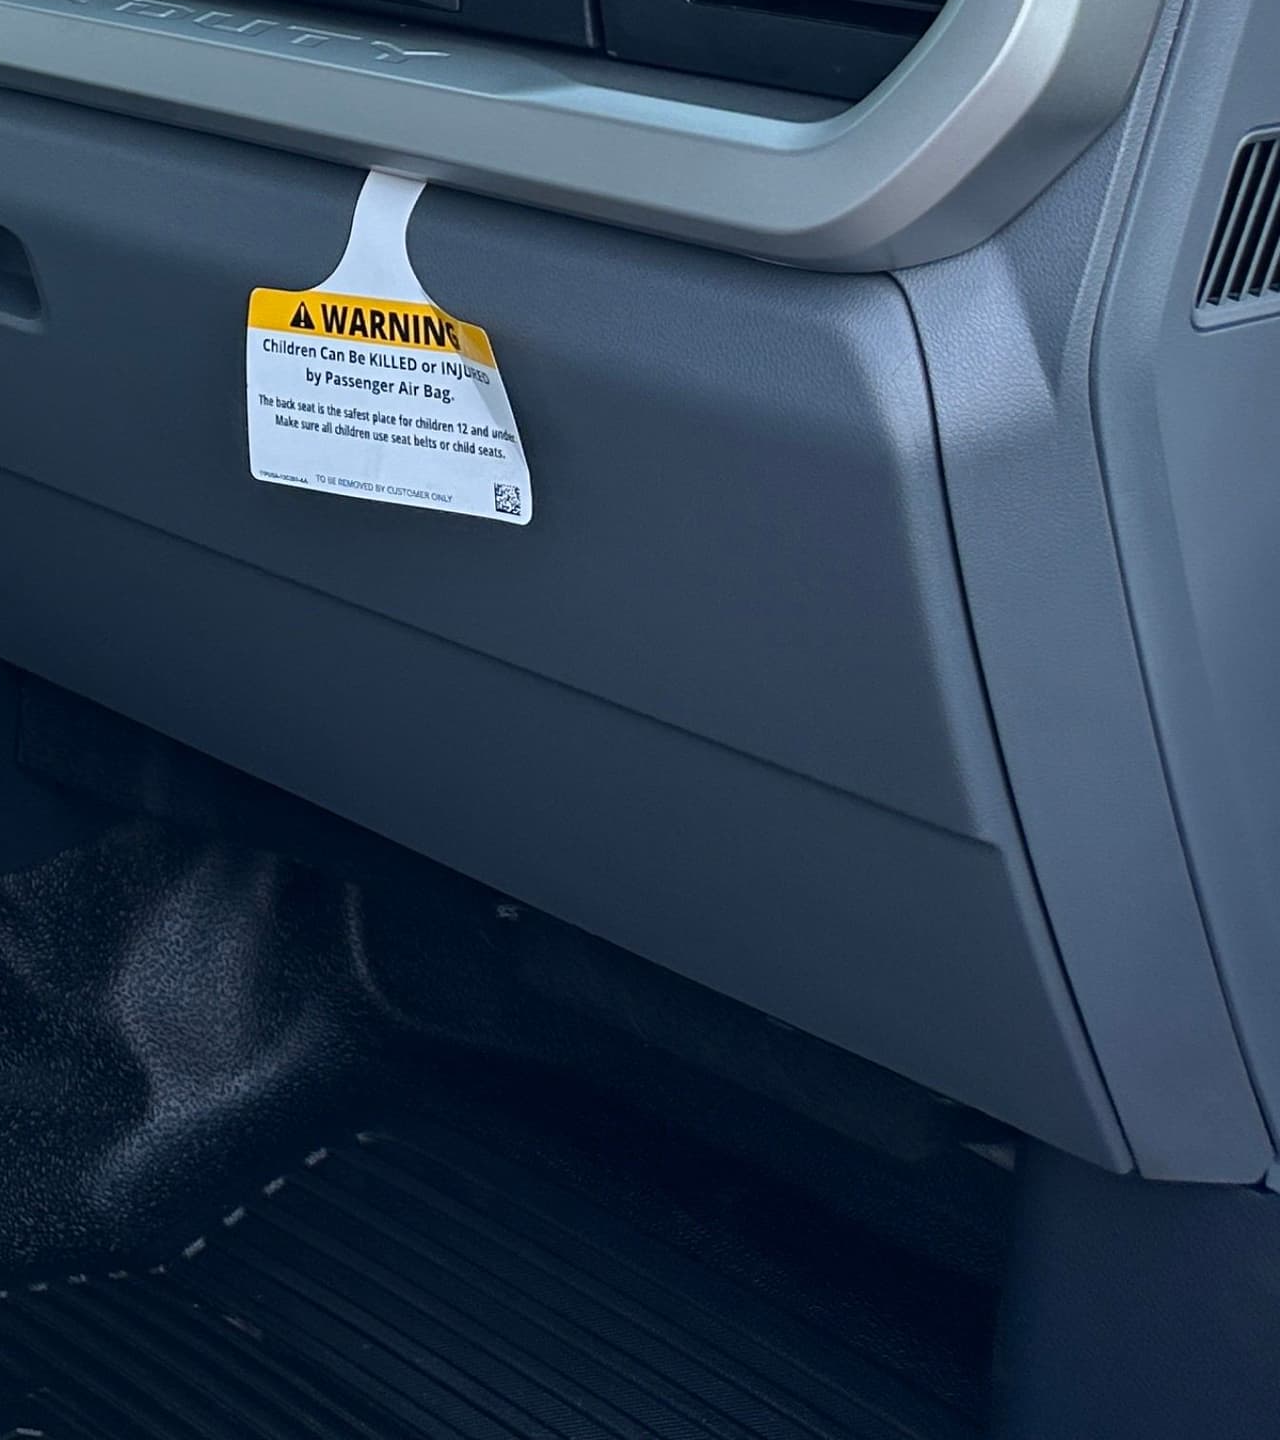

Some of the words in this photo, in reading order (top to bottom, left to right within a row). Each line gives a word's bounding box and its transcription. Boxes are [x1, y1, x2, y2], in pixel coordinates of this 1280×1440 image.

[321, 303, 461, 351] WARNING
[263, 338, 317, 358] Children
[320, 346, 345, 362] Can
[349, 350, 366, 365] Be
[369, 352, 417, 371] KILLED
[421, 361, 437, 374] or
[306, 367, 322, 386] by
[325, 370, 395, 395] Passenger
[398, 380, 420, 396] Air
[423, 384, 455, 404] Bag.
[259, 394, 274, 407] The
[276, 396, 296, 410] back
[297, 402, 316, 413] seat
[318, 402, 325, 415] is
[327, 404, 342, 417] the
[344, 408, 370, 421] safest
[372, 411, 397, 426] place
[399, 413, 413, 427] for
[415, 416, 454, 433] children
[457, 423, 468, 435] 12
[471, 425, 489, 438] and
[275, 414, 299, 429] Make
[301, 419, 320, 432] sure
[321, 421, 333, 434] all
[334, 423, 371, 440] children
[372, 431, 389, 443] use
[391, 433, 412, 446] seat
[413, 434, 437, 449] belts
[439, 440, 450, 451] or
[452, 440, 476, 454] child
